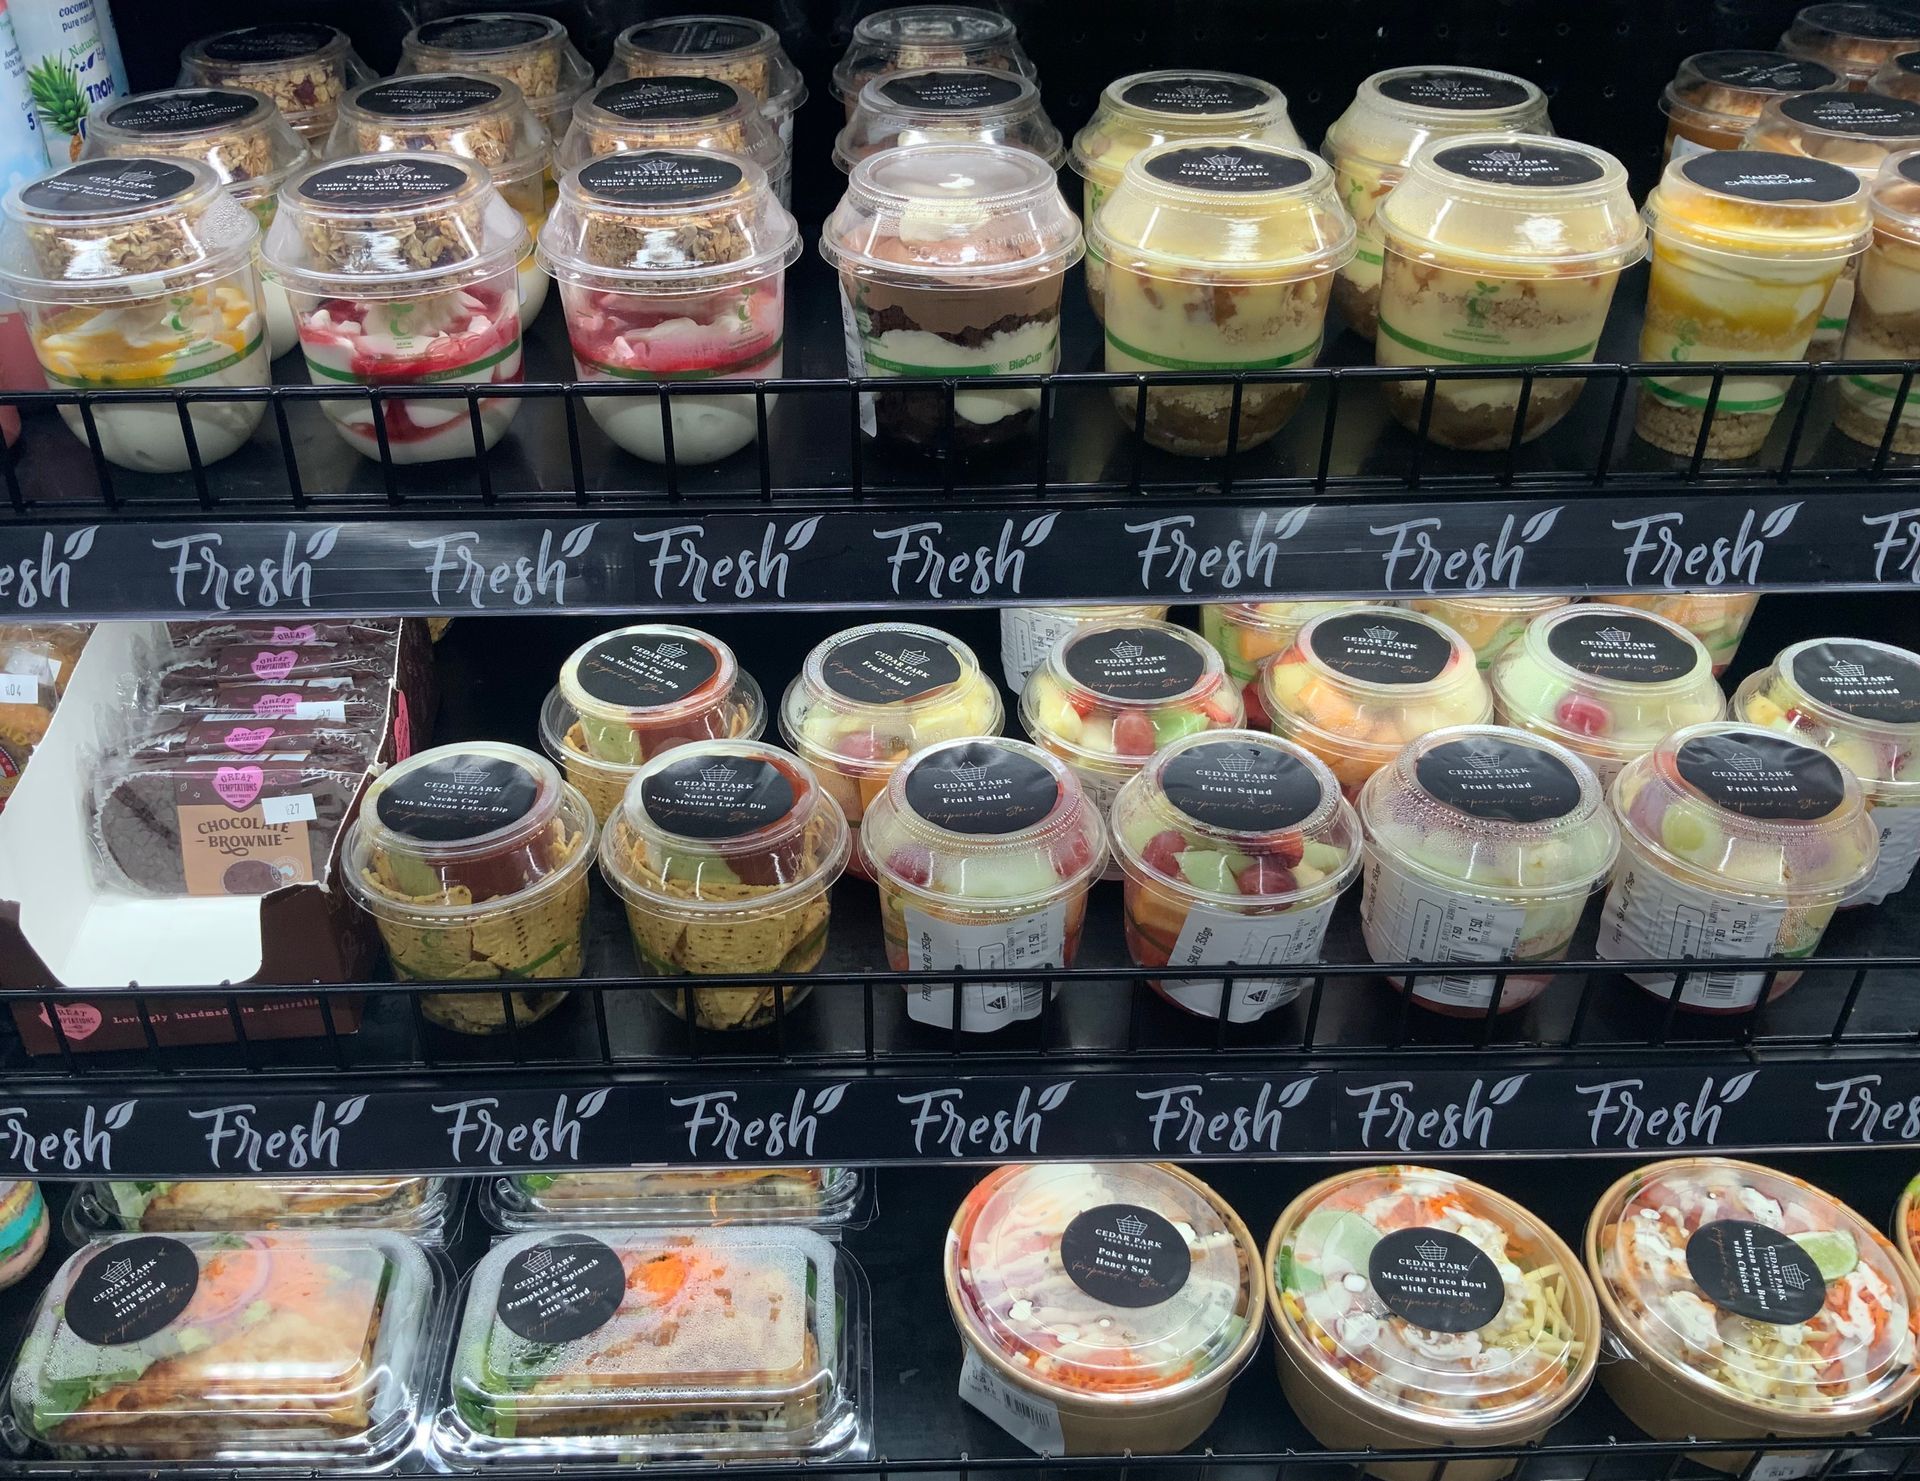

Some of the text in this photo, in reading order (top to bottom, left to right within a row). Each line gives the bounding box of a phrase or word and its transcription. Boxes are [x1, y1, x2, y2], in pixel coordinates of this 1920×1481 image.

[1724, 178, 1816, 187] CHEESECAKE
[1740, 173, 1789, 181] MANGO
[1008, 352, 1042, 371] BioCup
[873, 518, 1025, 599] Fresh
[1124, 510, 1280, 593] Fresh
[1369, 513, 1524, 594] Fresh
[1611, 508, 1764, 589] Fresh
[152, 531, 311, 610] Fresh
[408, 528, 567, 609] Fresh
[633, 521, 790, 603] Fresh
[1343, 635, 1418, 650] CEDAR PARK
[631, 645, 688, 671] CEDAR PARK
[1347, 647, 1412, 660] Fruit Salad
[600, 653, 679, 690] with Mexican Layer Dip
[628, 656, 663, 675] Nacho Cup
[862, 660, 911, 687] Fruit Salad
[875, 650, 930, 679] CEDAR PARK
[1135, 667, 1166, 675] Salad
[221, 774, 254, 783] GREAT
[1195, 770, 1279, 781] CEDAR PARK
[1495, 767, 1530, 775] PARK
[1759, 769, 1794, 777] PARK
[218, 783, 258, 792] TEMPTATIONS
[424, 781, 503, 794] CEDAR PARK
[674, 780, 754, 790] CEDAR PARK
[934, 778, 1013, 790] CEDAR PARK
[1201, 784, 1273, 795] Fruit Salad
[1460, 781, 1533, 791] Fruit Salad
[1726, 784, 1798, 793] Fruit Salad
[430, 795, 458, 803] Nacho
[651, 795, 671, 803] with
[674, 799, 715, 807] Mexican
[684, 793, 713, 801] Nacho
[943, 793, 1011, 804] Fruit Salad
[419, 801, 458, 810] Mexican
[460, 804, 488, 812] Layer
[491, 806, 509, 814] Dip
[208, 834, 282, 848] BROWNIE
[175, 1008, 230, 1020] handmad
[897, 1086, 1042, 1157] Fresh
[1136, 1082, 1282, 1155] Fresh
[1346, 1078, 1493, 1151] Fresh
[1575, 1077, 1722, 1150] Fresh
[432, 1093, 581, 1165] Fresh
[670, 1088, 818, 1160] Fresh
[189, 1101, 340, 1171] Fresh
[1095, 1228, 1162, 1249] CEDAR PARK
[1098, 1247, 1152, 1265] Poke Bowl
[1398, 1258, 1469, 1271] CEDAR PARK
[514, 1254, 577, 1290] CEDAR PARK
[1095, 1257, 1150, 1277] Honey Soy
[1733, 1240, 1750, 1293] with Chicken
[1744, 1228, 1770, 1310] Mexican Taco Bowl
[1767, 1245, 1787, 1301] CEDAR PARK
[92, 1259, 157, 1303] CEDAR PARK
[506, 1259, 599, 1310] Pumpkin & Spinach
[1382, 1271, 1487, 1289] Mexican Taco Bowl
[112, 1280, 153, 1308] Lasagne
[115, 1282, 167, 1318] with Salad
[538, 1284, 577, 1307] Lasagne
[1400, 1284, 1470, 1298] with Chicken
[540, 1287, 591, 1317] with Salad
